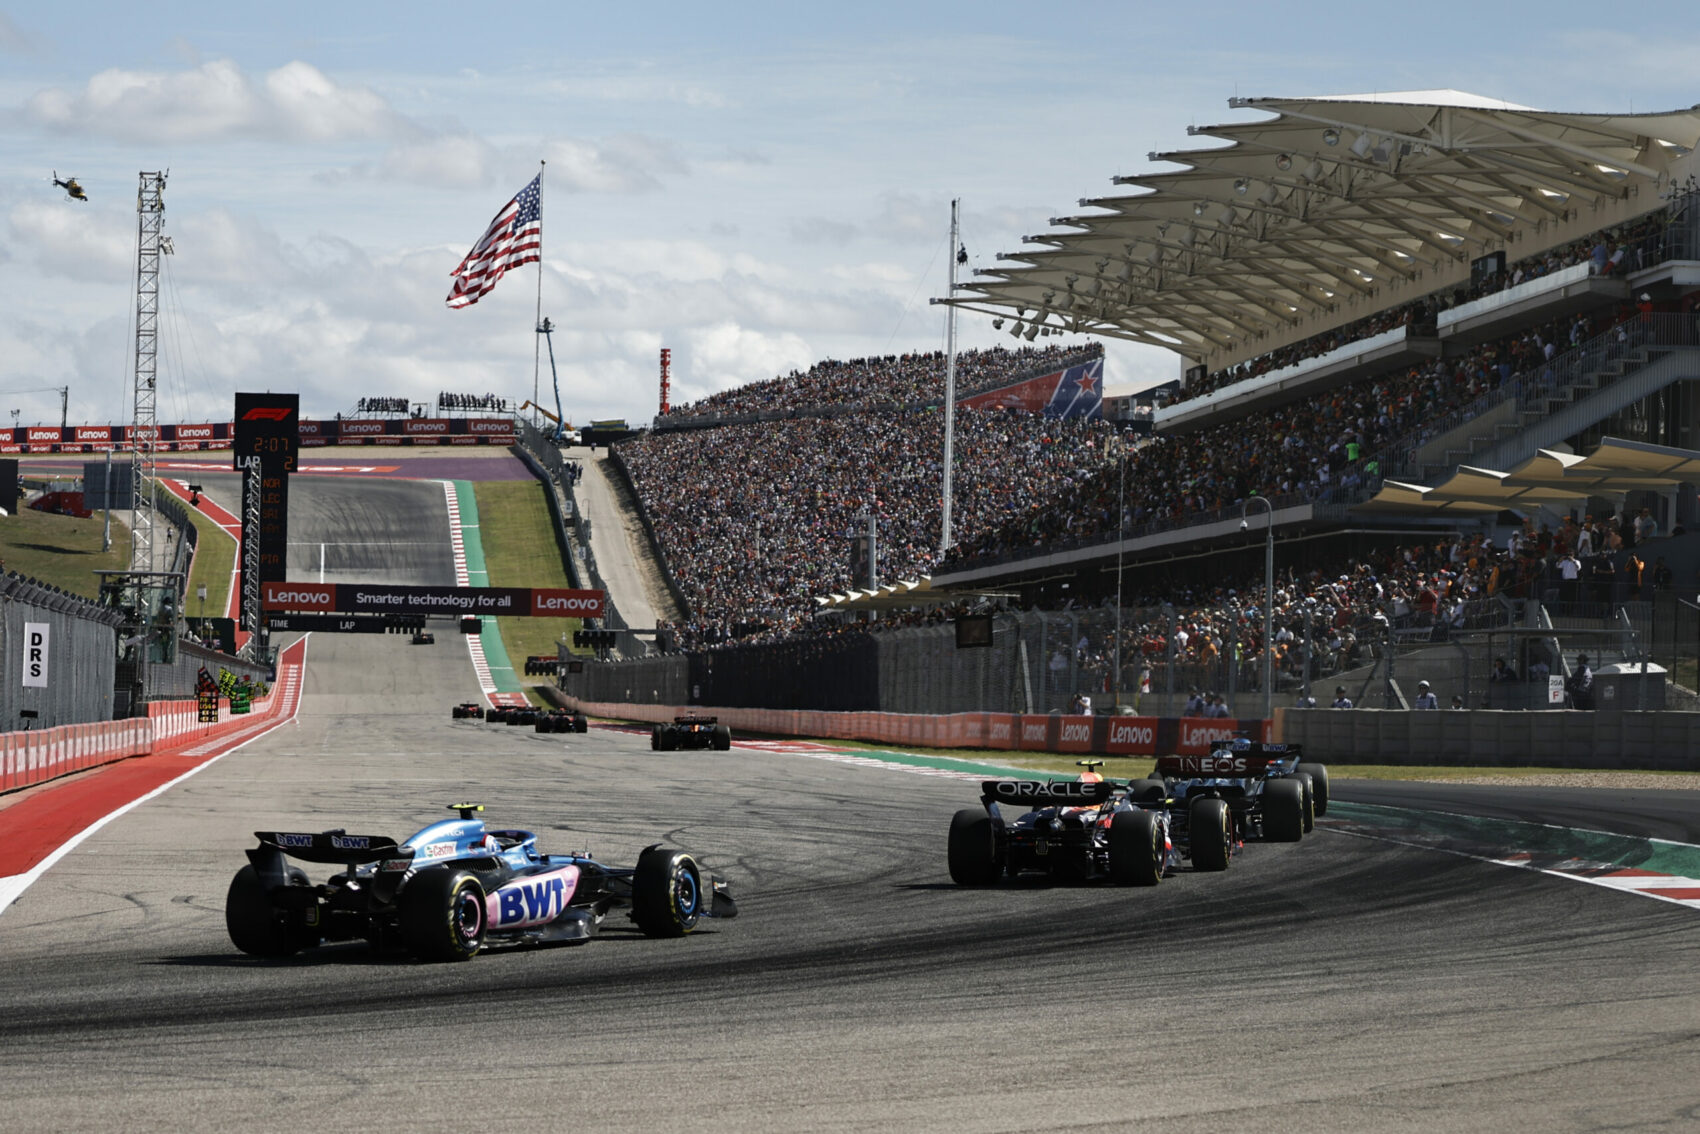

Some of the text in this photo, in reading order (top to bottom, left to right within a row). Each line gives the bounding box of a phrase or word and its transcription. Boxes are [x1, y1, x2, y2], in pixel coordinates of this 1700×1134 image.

[179, 427, 210, 437] Lenovo
[343, 423, 381, 433] Lenovo
[407, 422, 446, 432] Lenovo
[471, 421, 510, 432] Lenovo
[29, 430, 59, 440] Lenovo
[78, 429, 108, 439] Lenovo
[254, 437, 288, 452] 2:07
[237, 455, 260, 469] LAP
[243, 585, 250, 595] 8
[268, 588, 330, 604] Lenovo
[356, 592, 511, 608] Smarter technology for all
[537, 595, 598, 610] Lenovo
[270, 619, 288, 628] TIME
[340, 621, 356, 630] LAP
[30, 632, 42, 677] DRS
[1552, 690, 1559, 700] F
[1061, 719, 1089, 742] Lenovo
[1110, 721, 1152, 744] Lenovo
[1183, 723, 1233, 746] Lenovo
[1180, 758, 1247, 772] INEOS
[996, 782, 1097, 796] ORACLE
[285, 835, 312, 847] BWT
[340, 837, 370, 849] BWT
[497, 877, 565, 925] BWT
